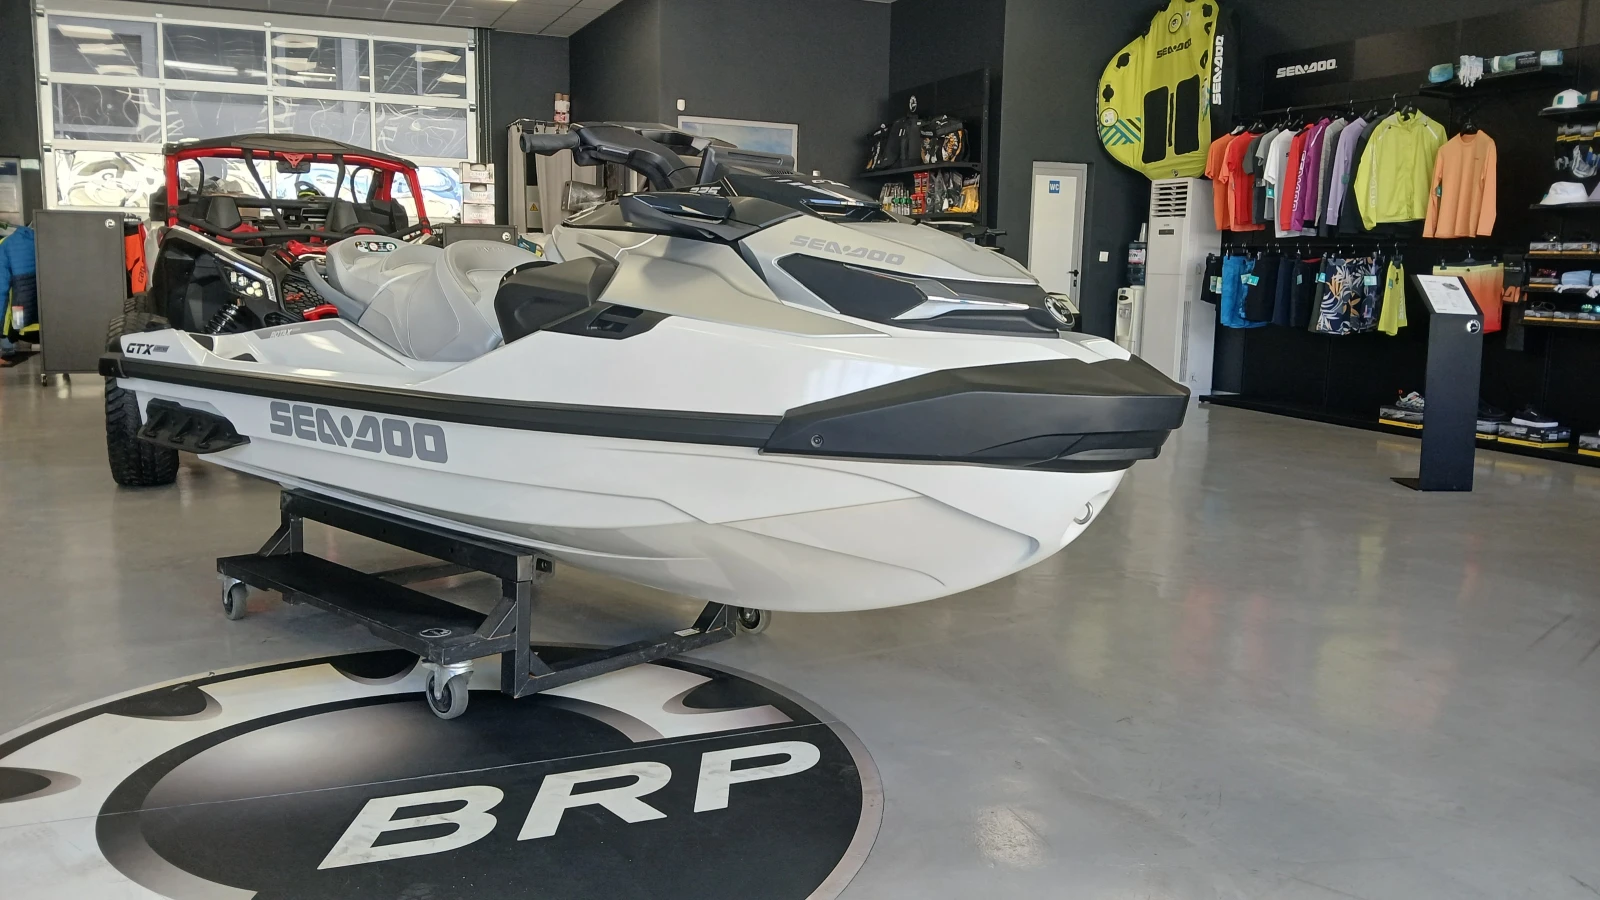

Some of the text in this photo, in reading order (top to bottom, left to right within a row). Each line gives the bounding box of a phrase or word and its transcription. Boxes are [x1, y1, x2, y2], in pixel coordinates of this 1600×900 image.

[1050, 183, 1060, 191] WC
[126, 342, 154, 356] GTX
[316, 740, 822, 871] BRP
